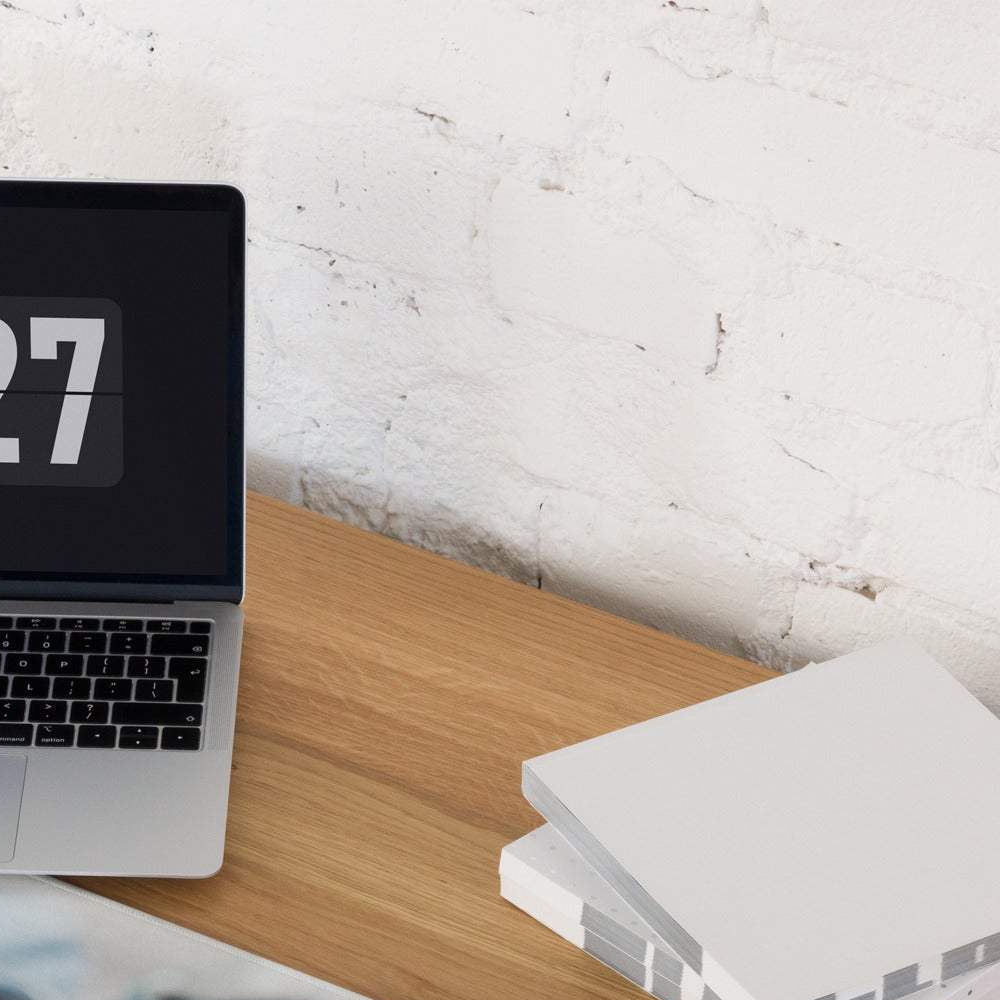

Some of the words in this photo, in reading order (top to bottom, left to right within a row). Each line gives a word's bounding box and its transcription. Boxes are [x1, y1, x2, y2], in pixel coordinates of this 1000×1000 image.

[1, 640, 10, 648] 9
[42, 641, 51, 649] 0
[18, 659, 29, 668] O
[59, 660, 69, 669] P
[26, 683, 33, 691] L
